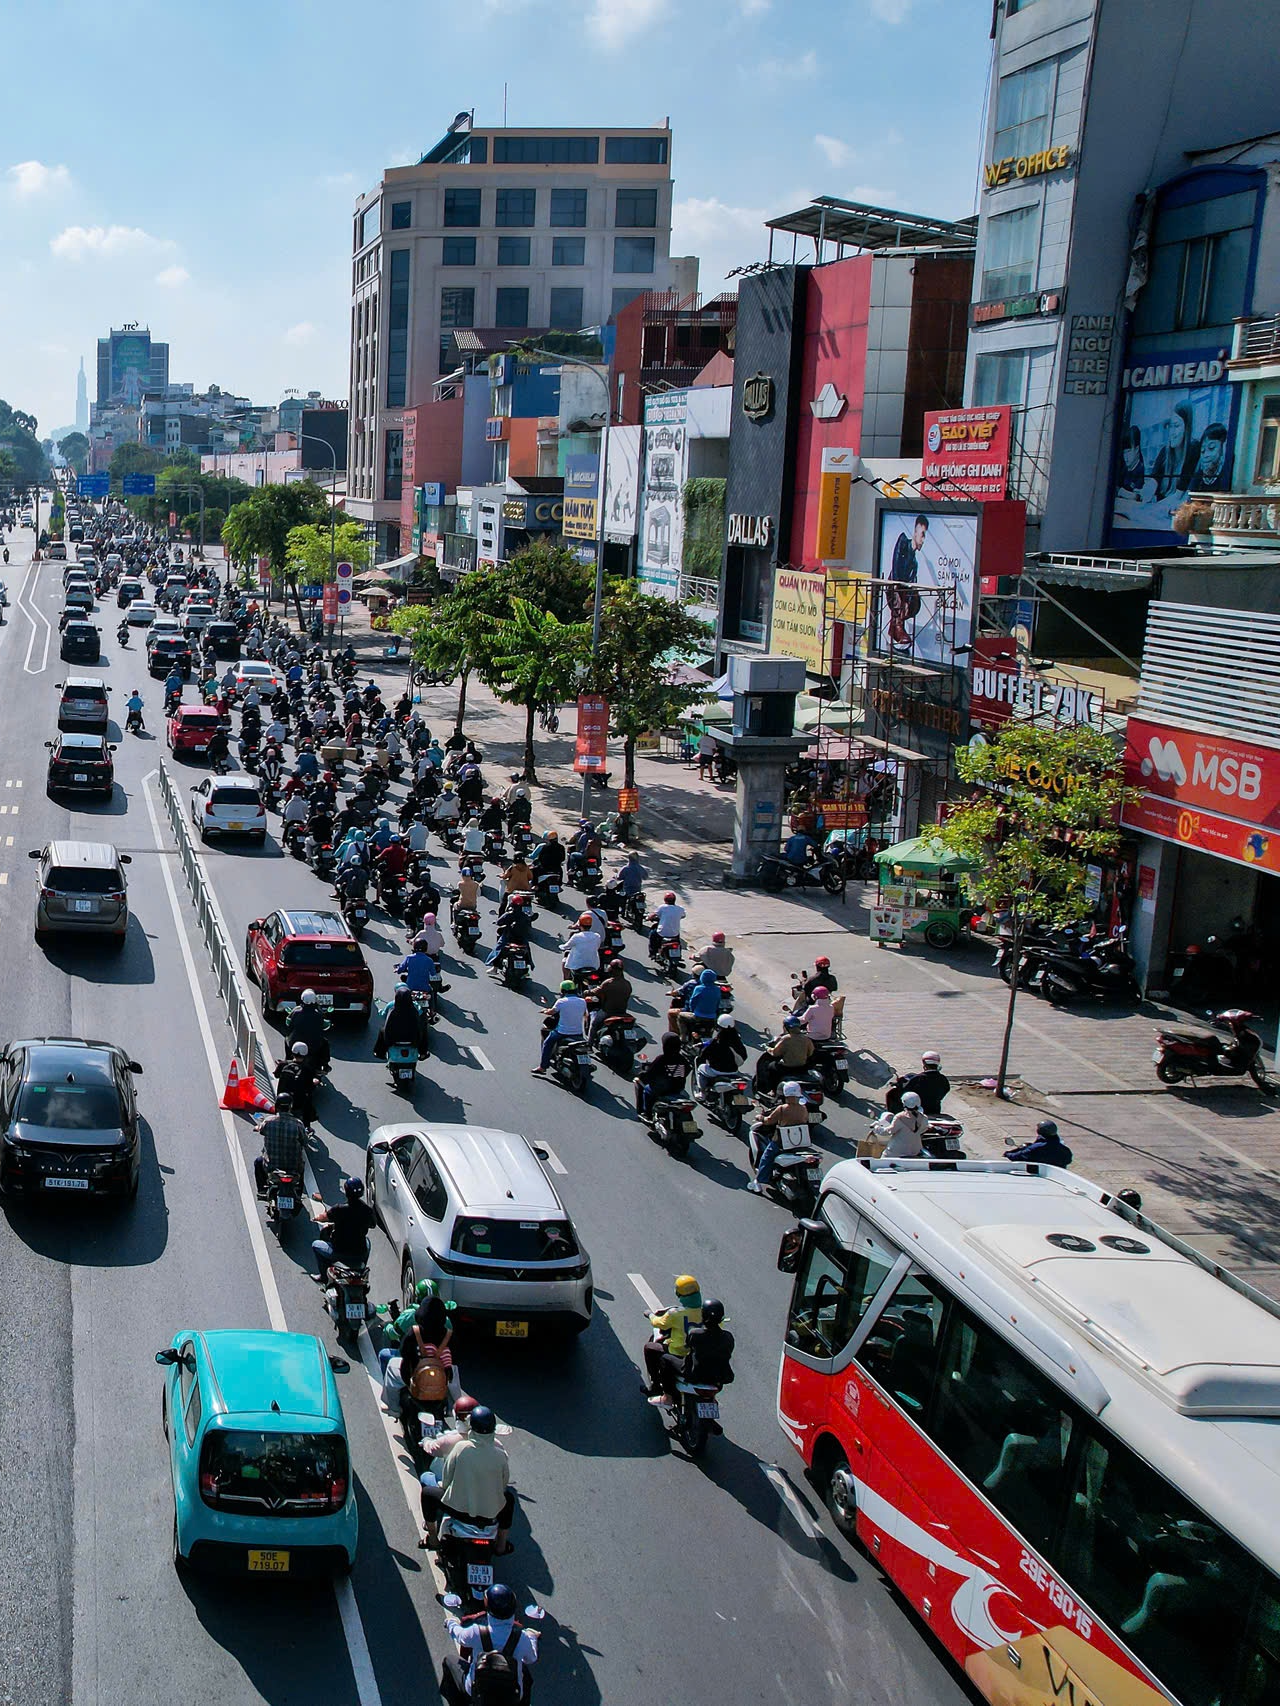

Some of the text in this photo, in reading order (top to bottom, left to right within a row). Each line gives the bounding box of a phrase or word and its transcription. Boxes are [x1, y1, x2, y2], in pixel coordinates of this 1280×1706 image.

[984, 145, 1069, 187] WE OFFICE
[1122, 360, 1223, 388] I CAN READ
[941, 421, 996, 440] SAO VIỆT
[940, 461, 966, 477] PHÒNG
[967, 464, 980, 477] GHI
[981, 464, 1002, 477] DANH
[728, 514, 770, 546] DALLAS
[973, 666, 1093, 724] BUFFET 79K
[1192, 751, 1262, 801] MSB
